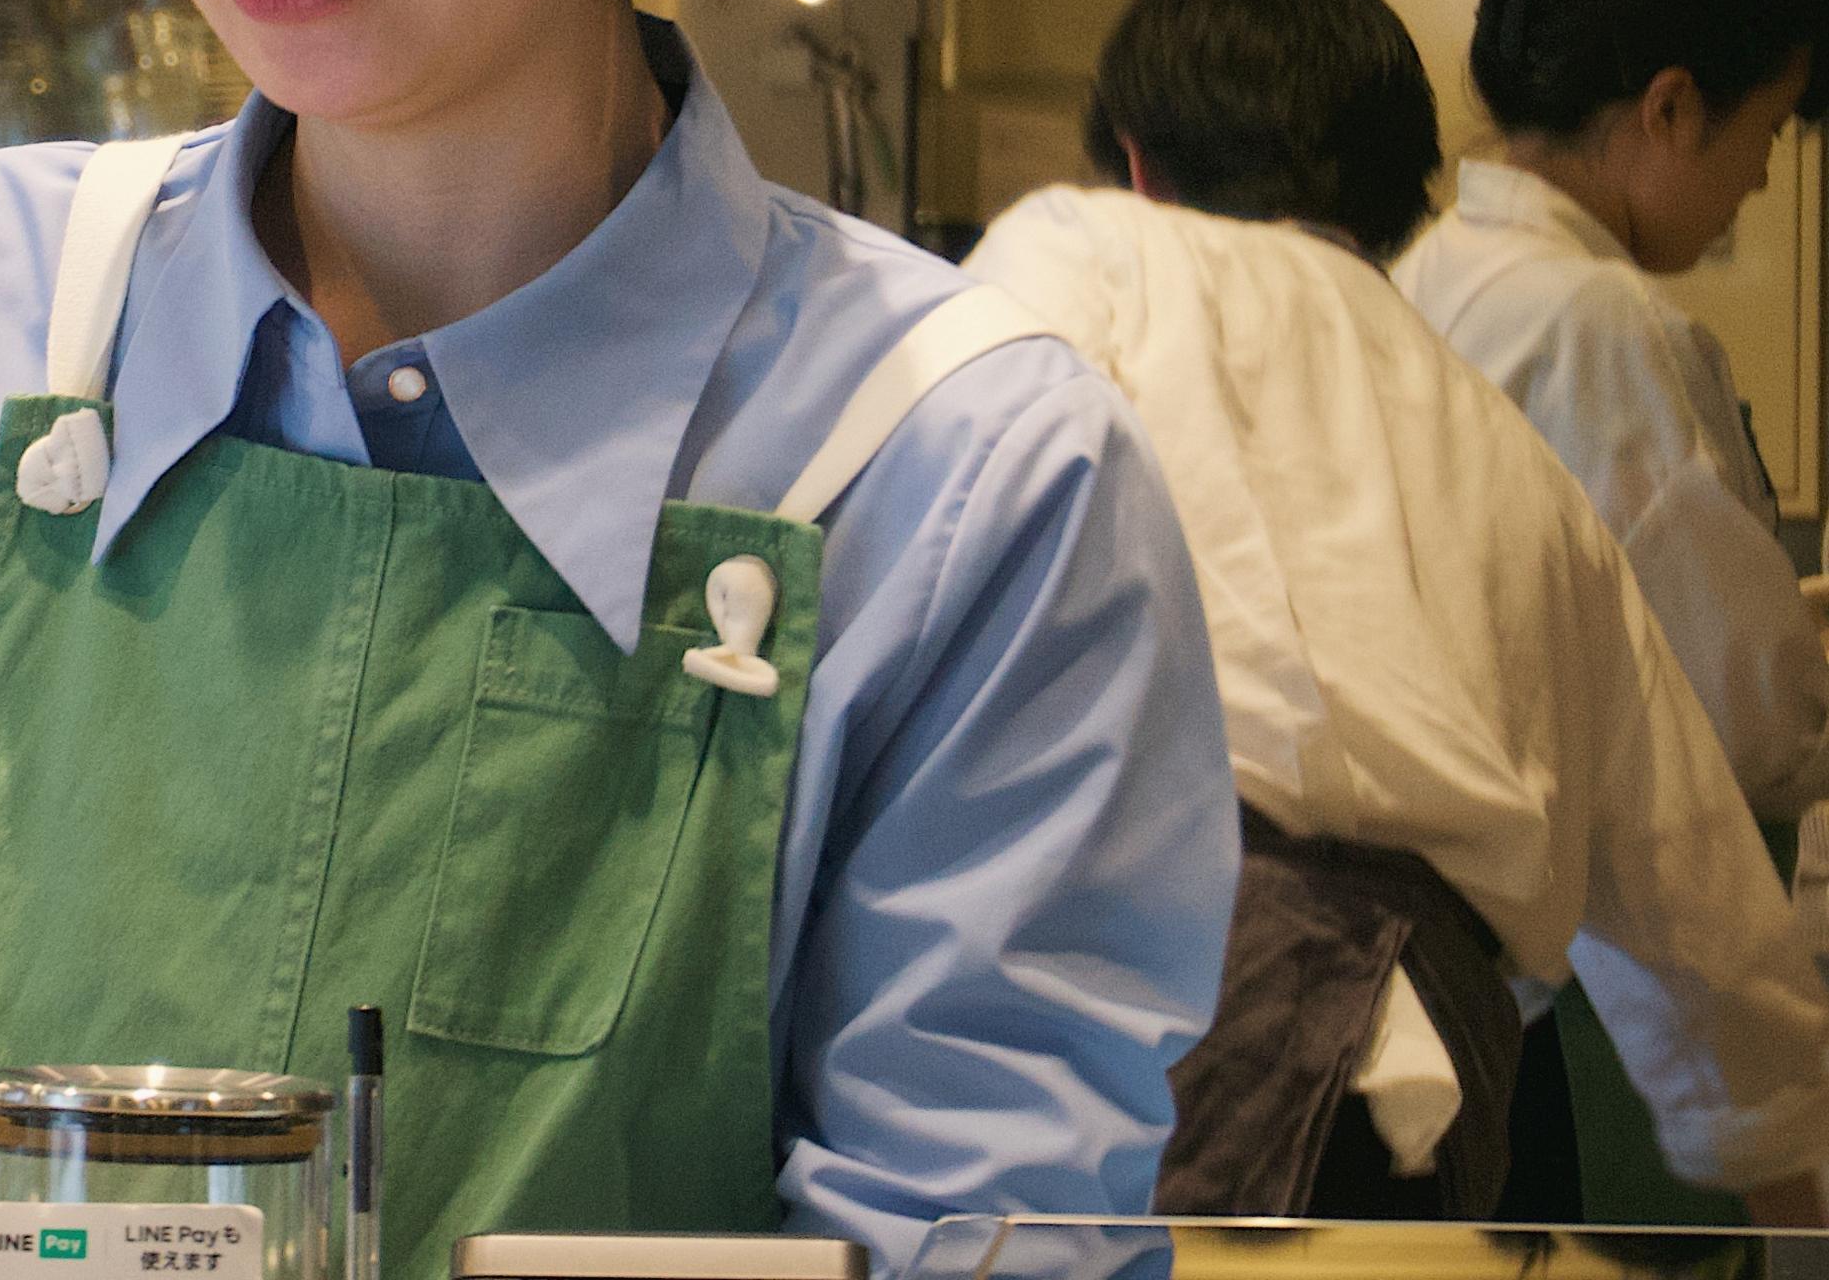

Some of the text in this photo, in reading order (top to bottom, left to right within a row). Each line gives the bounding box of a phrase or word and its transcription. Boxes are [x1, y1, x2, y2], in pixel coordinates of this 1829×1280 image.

[44, 1234, 81, 1253] Pay
[125, 1225, 172, 1243] LINE
[140, 1251, 223, 1271] 使えます
